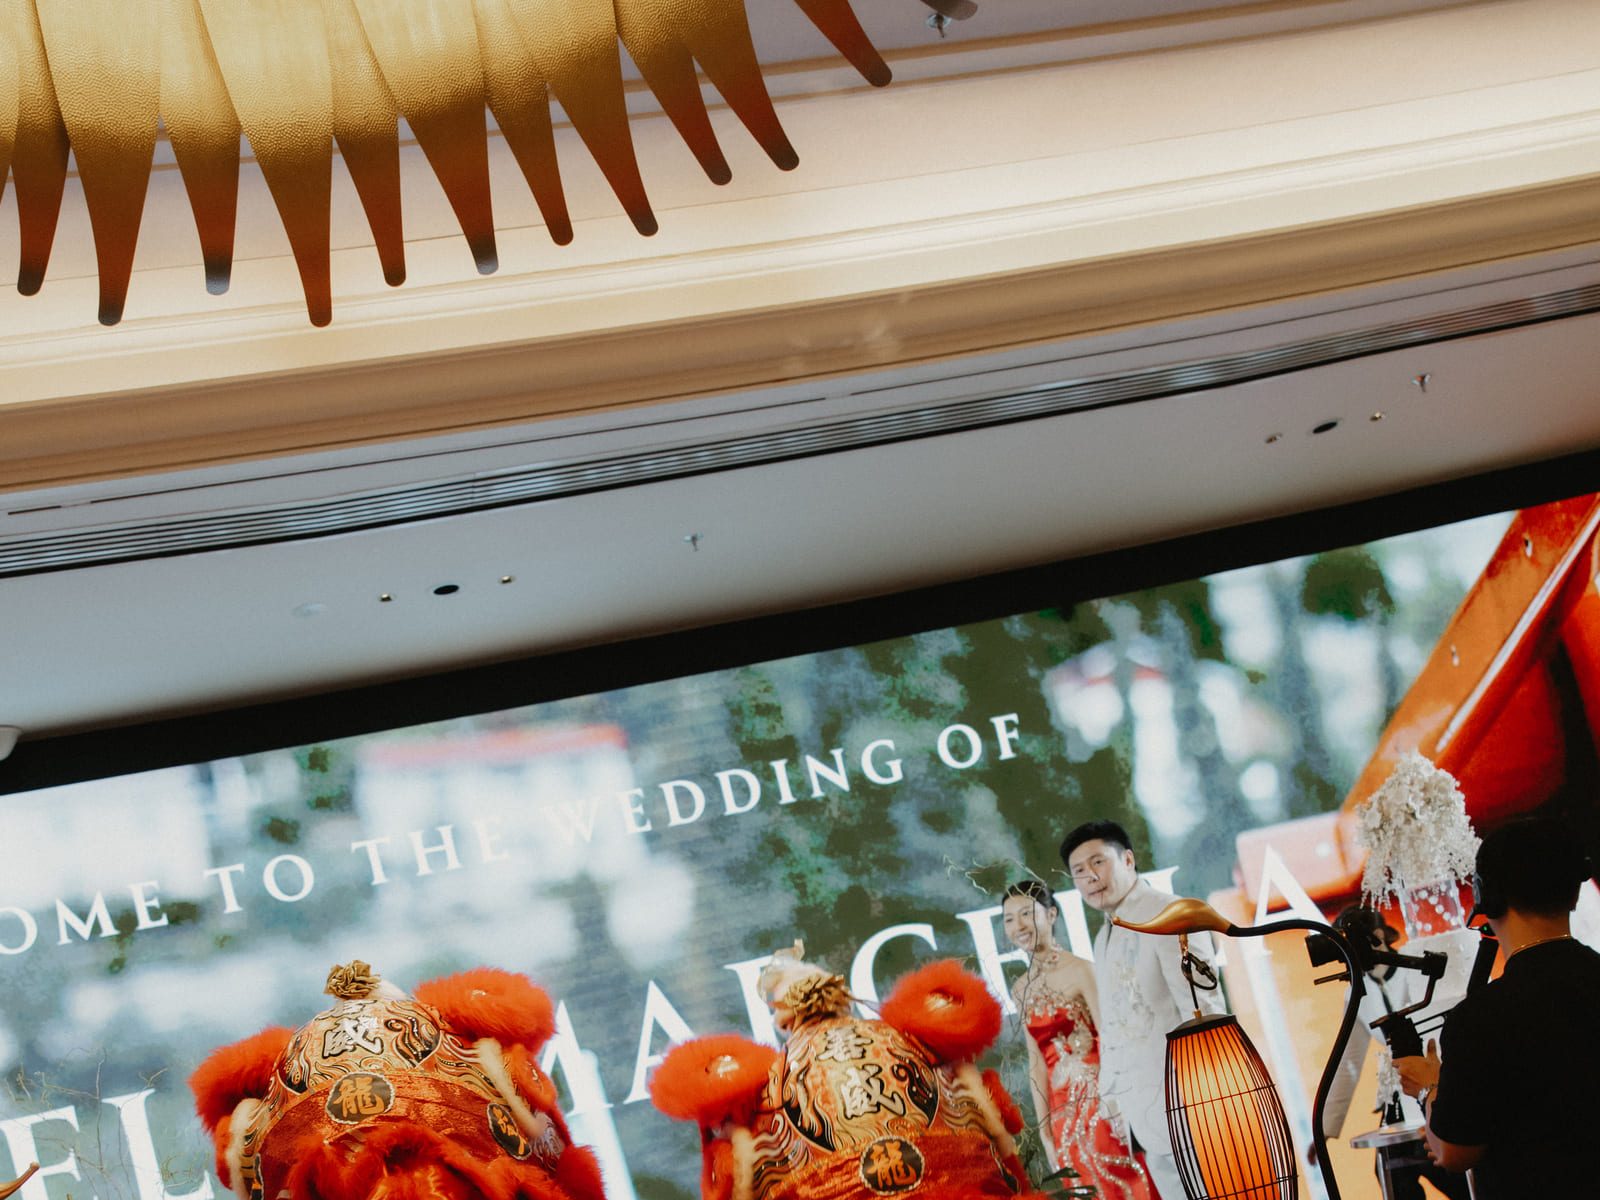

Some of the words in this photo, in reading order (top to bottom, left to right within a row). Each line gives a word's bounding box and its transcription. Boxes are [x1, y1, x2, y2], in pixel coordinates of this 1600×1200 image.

[0, 880, 168, 955] OME
[203, 854, 315, 914] TO
[351, 818, 510, 886] THE
[539, 738, 903, 847] WEDDING
[937, 713, 1020, 770] OF
[333, 1076, 385, 1118] 龍
[866, 1140, 917, 1188] 龍
